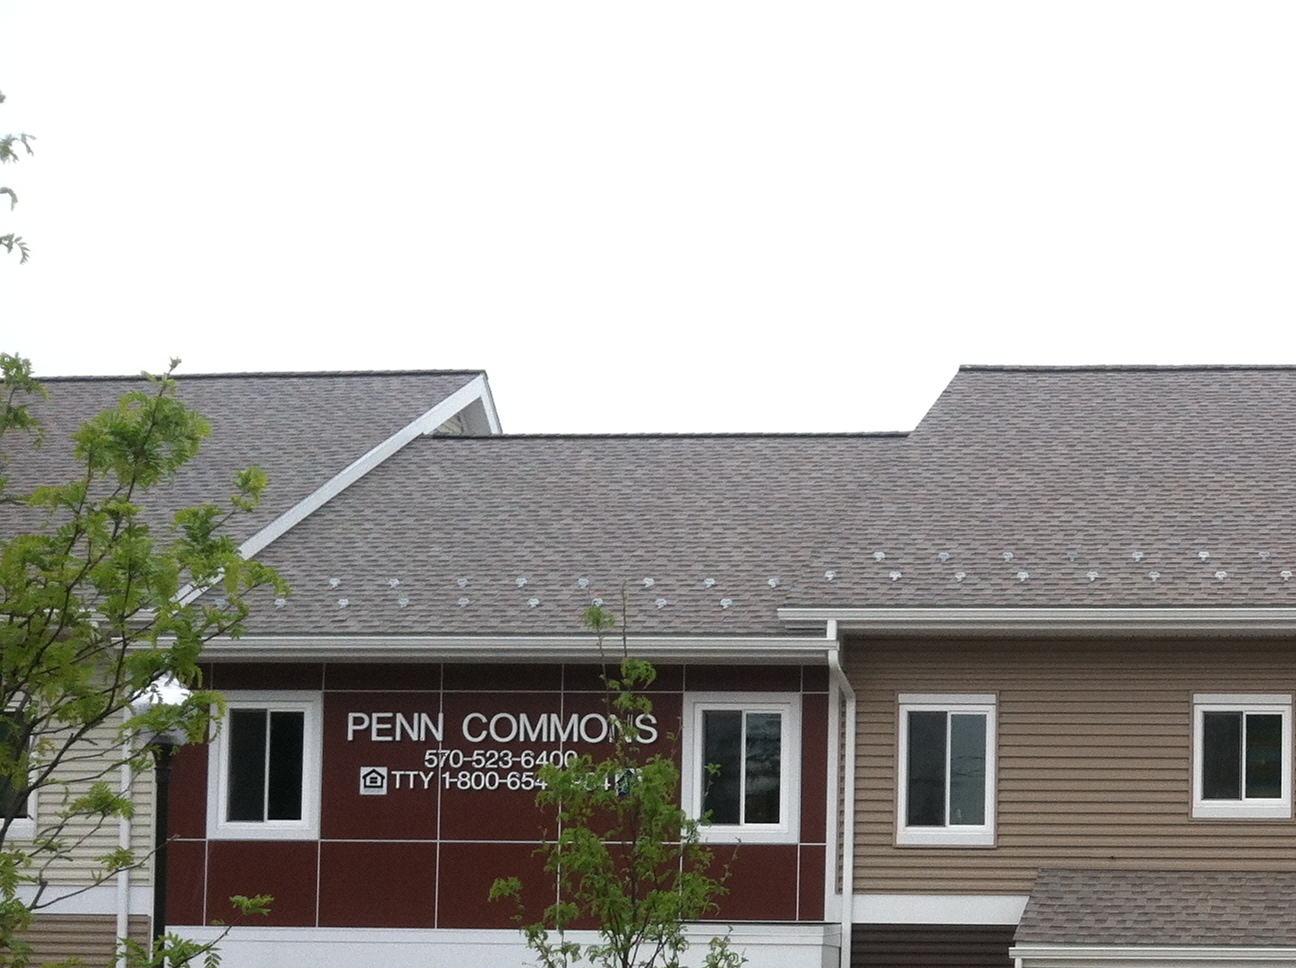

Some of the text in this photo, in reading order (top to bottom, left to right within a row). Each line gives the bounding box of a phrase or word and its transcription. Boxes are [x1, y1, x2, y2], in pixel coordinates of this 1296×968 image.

[347, 712, 659, 743] PENN COMMONS
[424, 749, 578, 769] 570-523-6400
[391, 770, 434, 789] TTY
